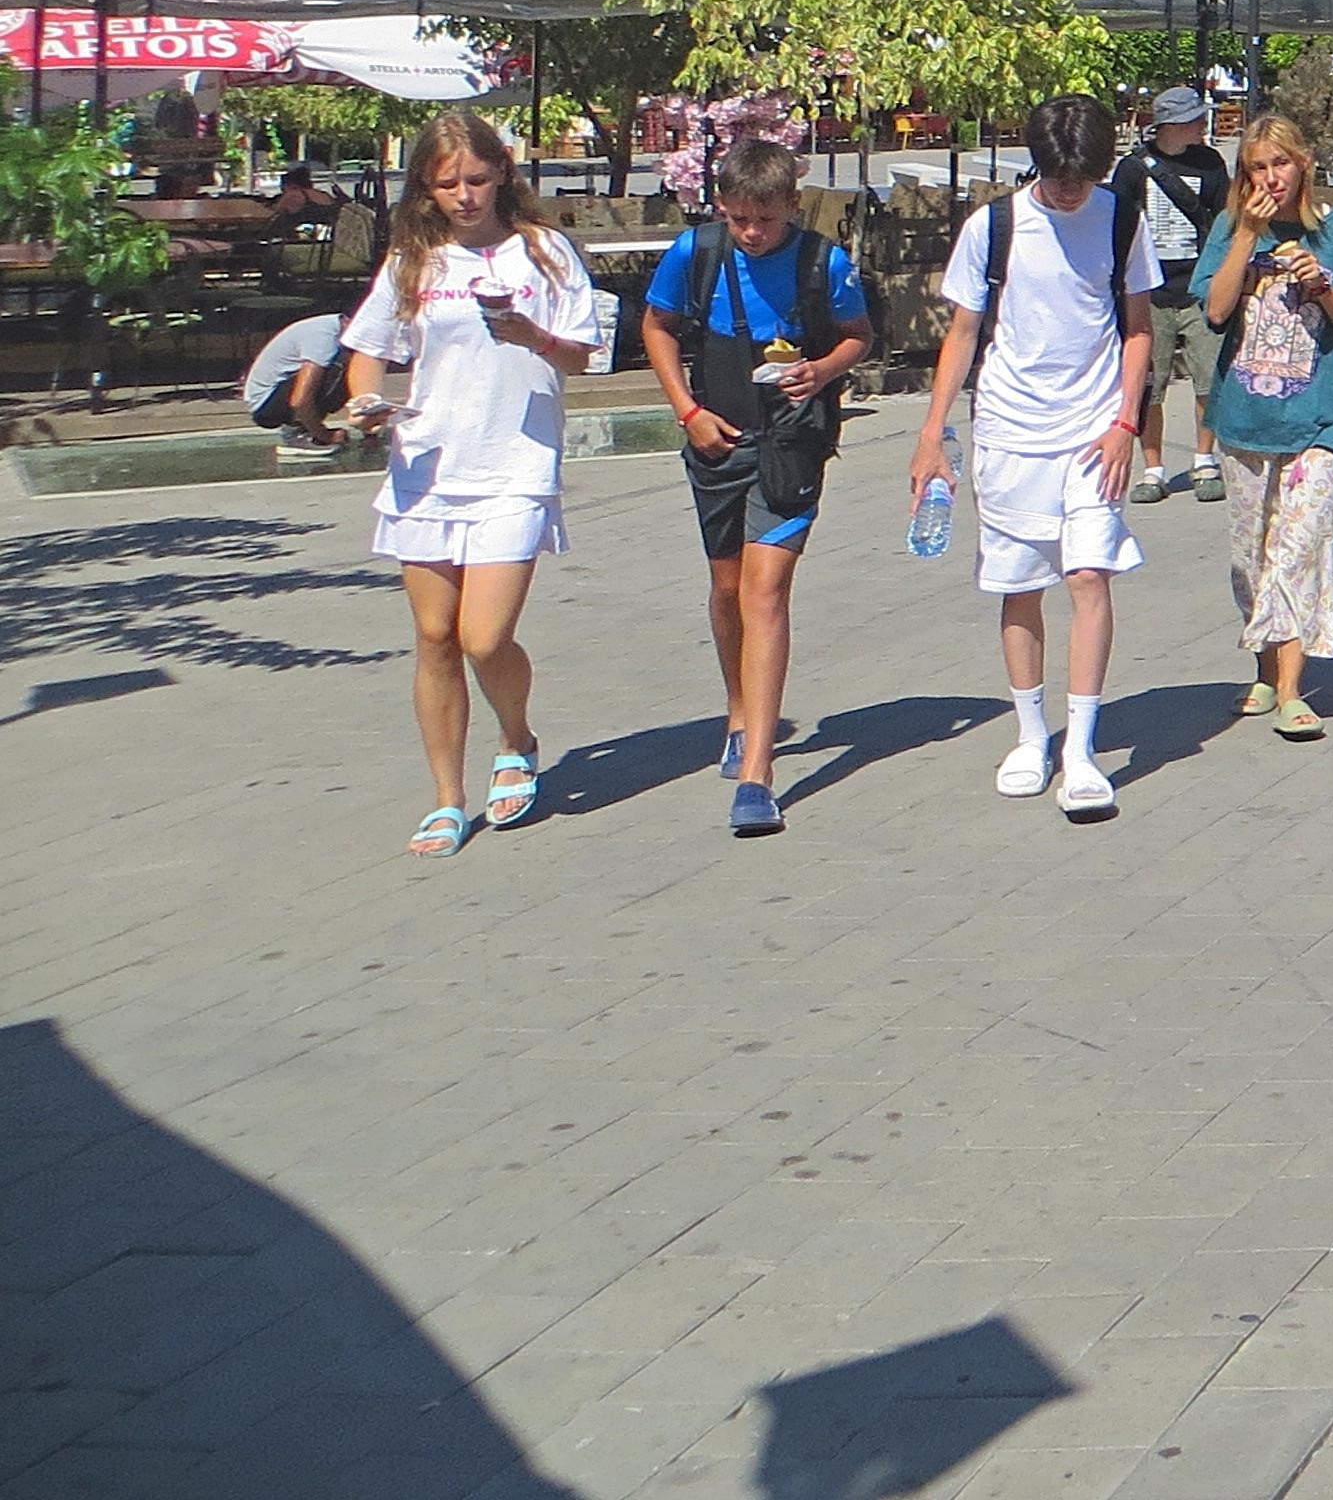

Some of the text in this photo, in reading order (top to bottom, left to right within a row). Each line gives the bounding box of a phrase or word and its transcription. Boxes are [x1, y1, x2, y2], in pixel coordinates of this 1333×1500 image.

[43, 17, 233, 38] STELLA
[41, 34, 237, 59] ARTOIS
[368, 64, 411, 75] STELLA
[420, 289, 477, 301] CONV
